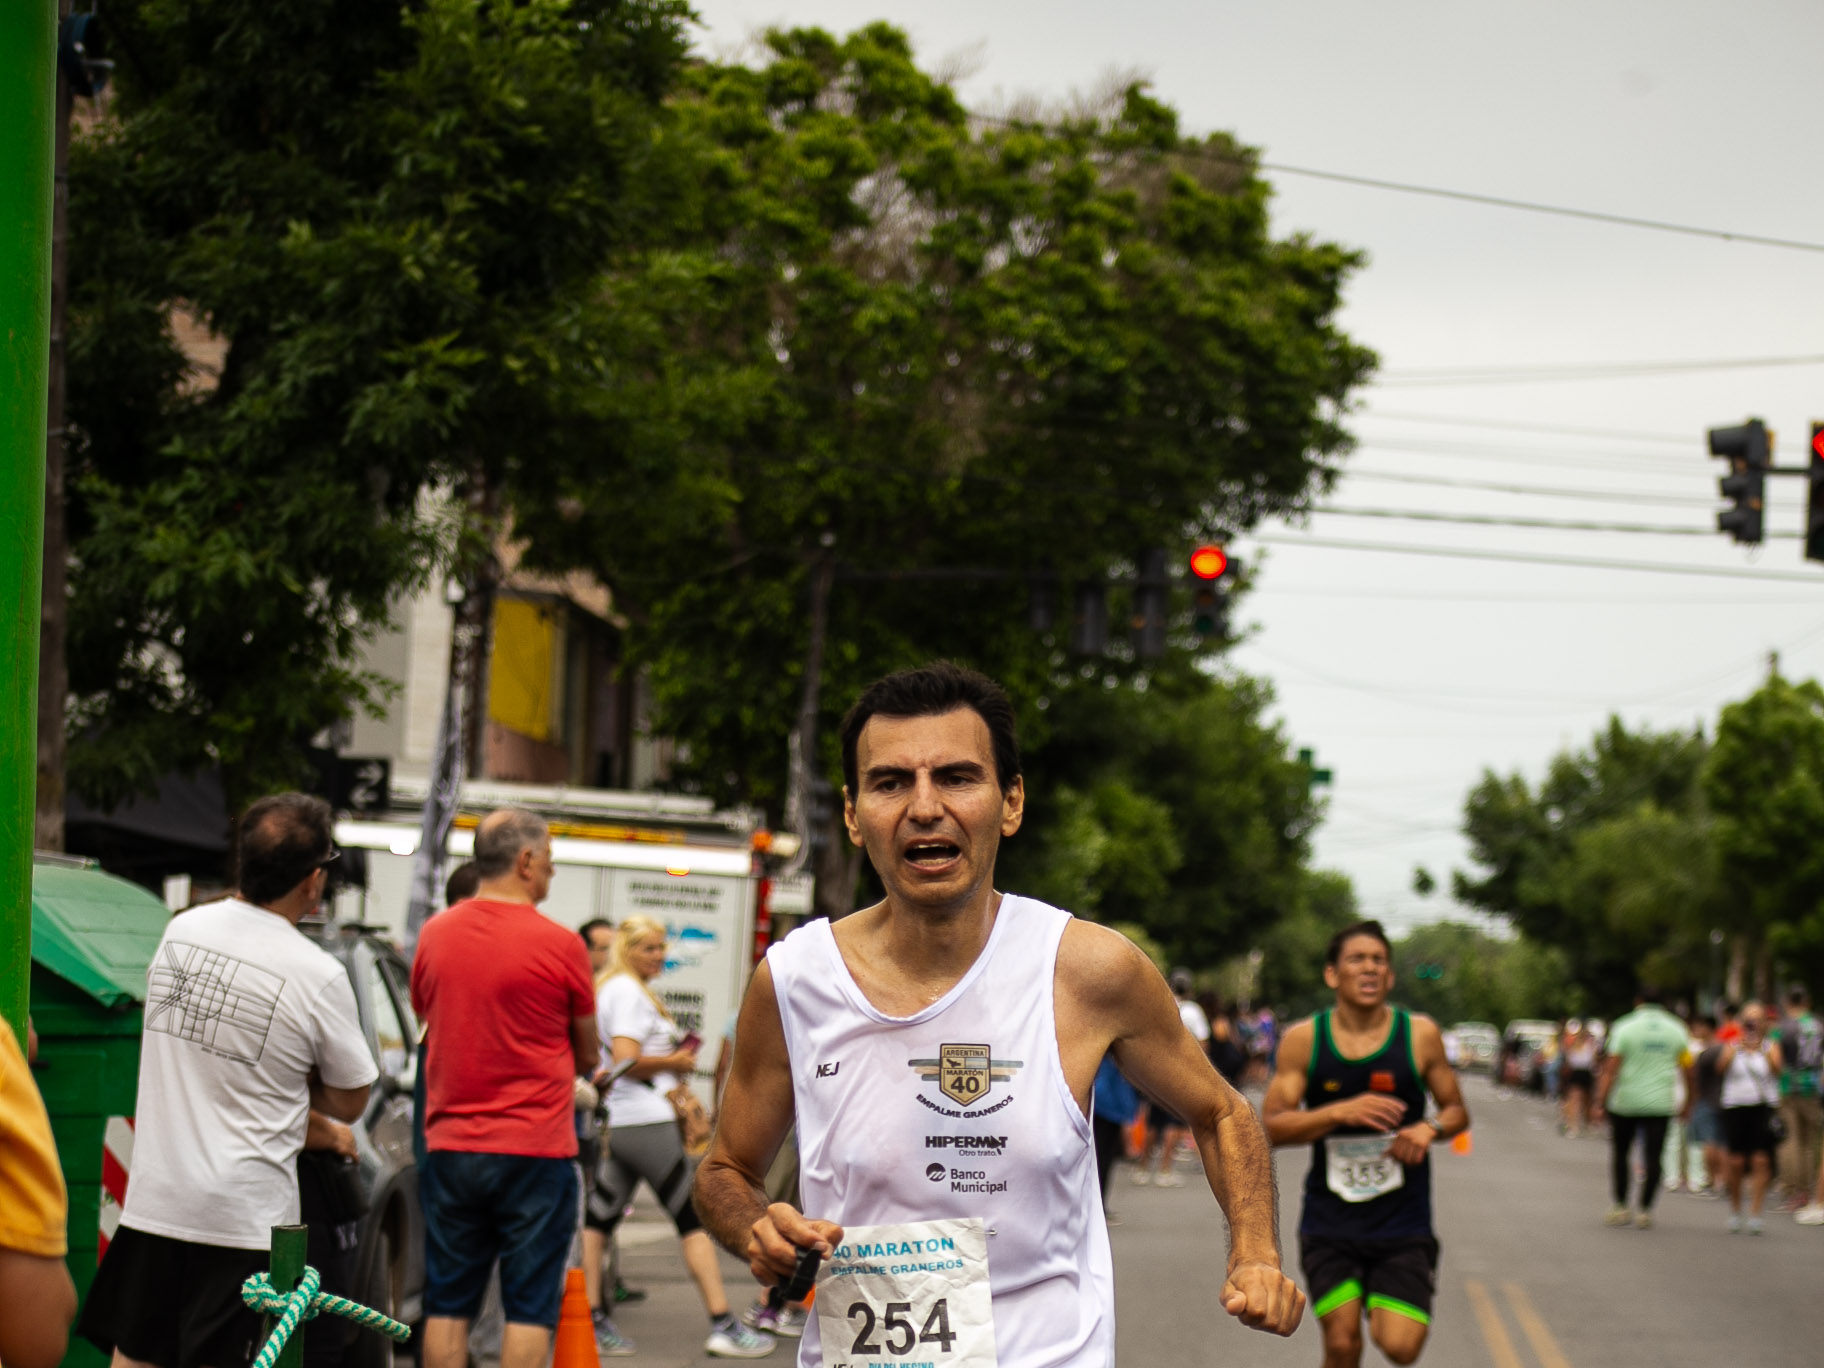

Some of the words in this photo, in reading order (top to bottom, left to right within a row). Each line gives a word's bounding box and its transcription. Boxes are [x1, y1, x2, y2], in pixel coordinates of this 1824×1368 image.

[945, 1049, 985, 1057] ARGENTINA
[815, 1061, 840, 1079] NEJ
[945, 1068, 984, 1077] MARATÓN
[950, 1076, 980, 1094] 40
[916, 1093, 962, 1118] EMPALME
[963, 1094, 1014, 1118] GRANEROS
[958, 1149, 976, 1157] Otro
[950, 1168, 986, 1180] Banco
[950, 1180, 1008, 1195] Municipal
[833, 1245, 851, 1260] 40
[856, 1237, 955, 1258] MARATON
[830, 1265, 887, 1277] EMPALME
[890, 1258, 964, 1276] GRANEROS
[847, 1298, 957, 1356] 254
